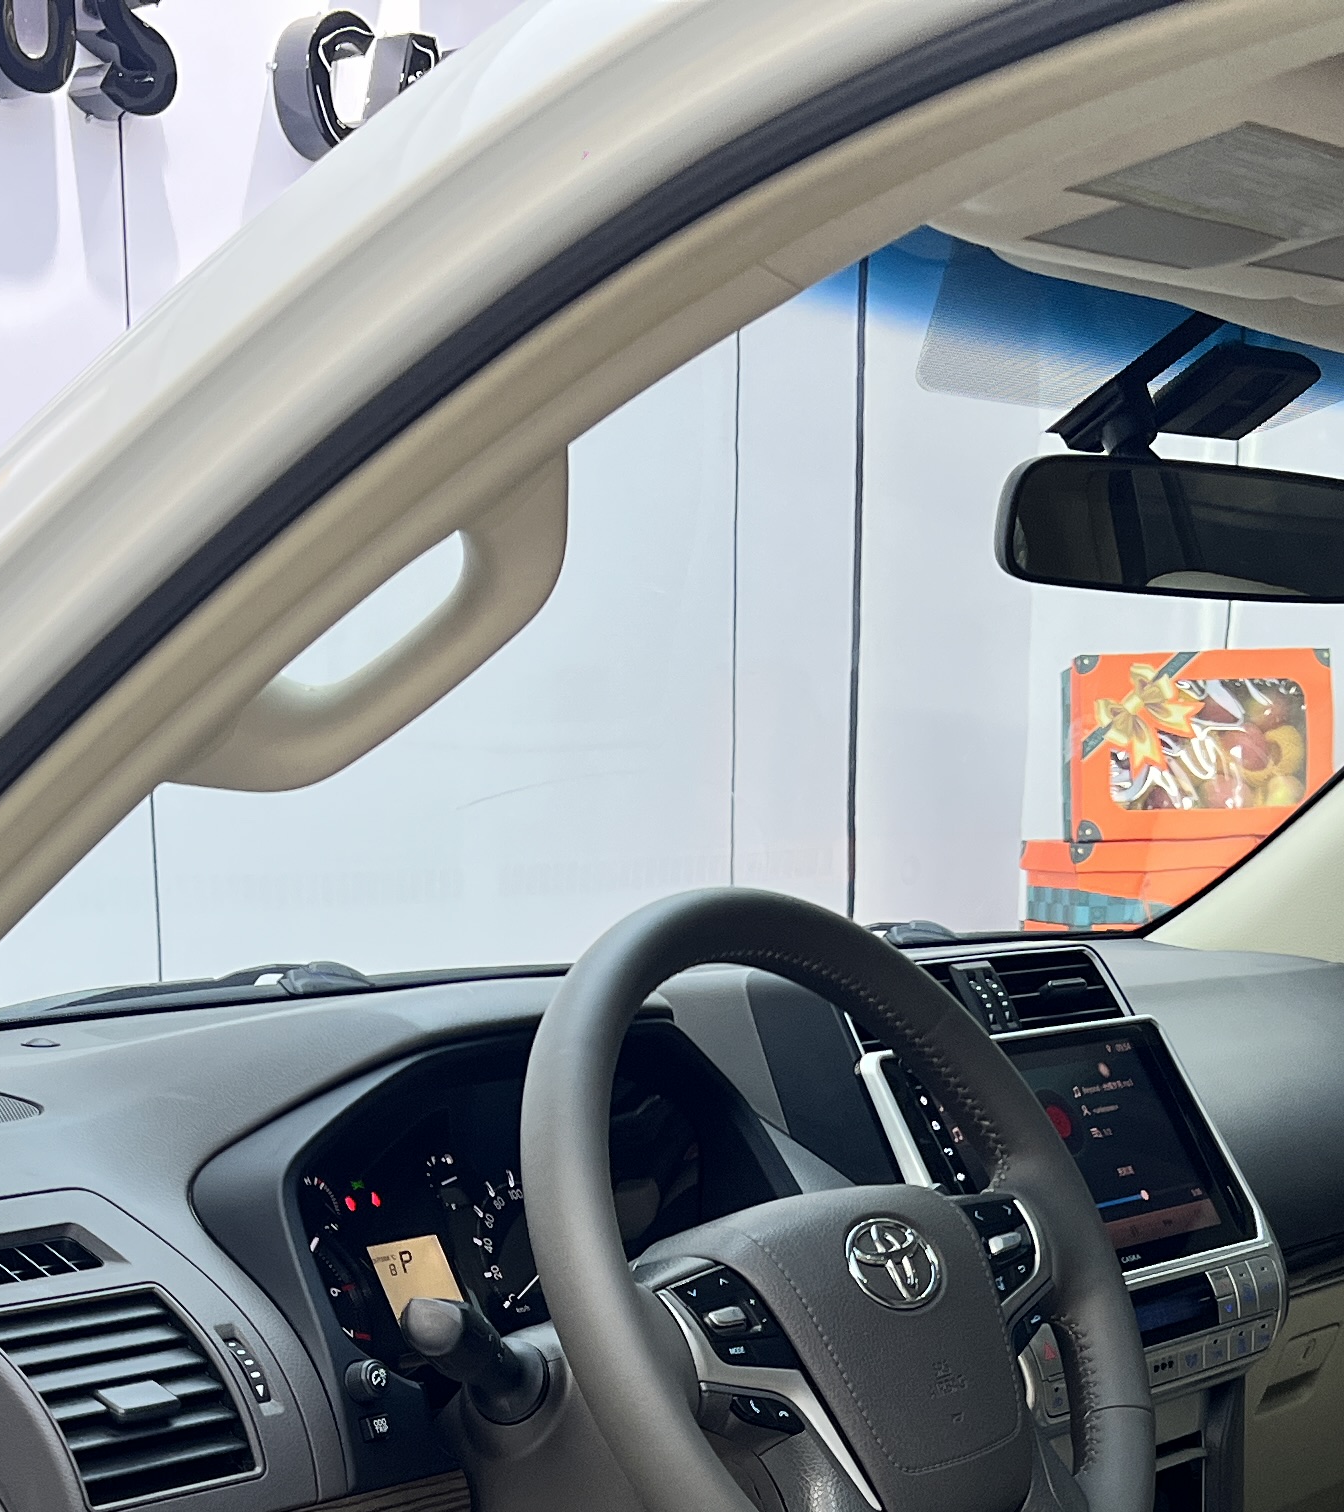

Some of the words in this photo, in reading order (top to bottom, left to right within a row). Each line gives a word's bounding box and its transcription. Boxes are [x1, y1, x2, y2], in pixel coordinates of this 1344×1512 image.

[507, 1188, 524, 1201] 100
[484, 1213, 495, 1229] 60
[483, 1237, 494, 1254] 40
[399, 1250, 413, 1274] P
[388, 1263, 398, 1277] 8
[490, 1265, 503, 1281] 20
[330, 1286, 341, 1297] 6
[341, 1326, 354, 1339] 7
